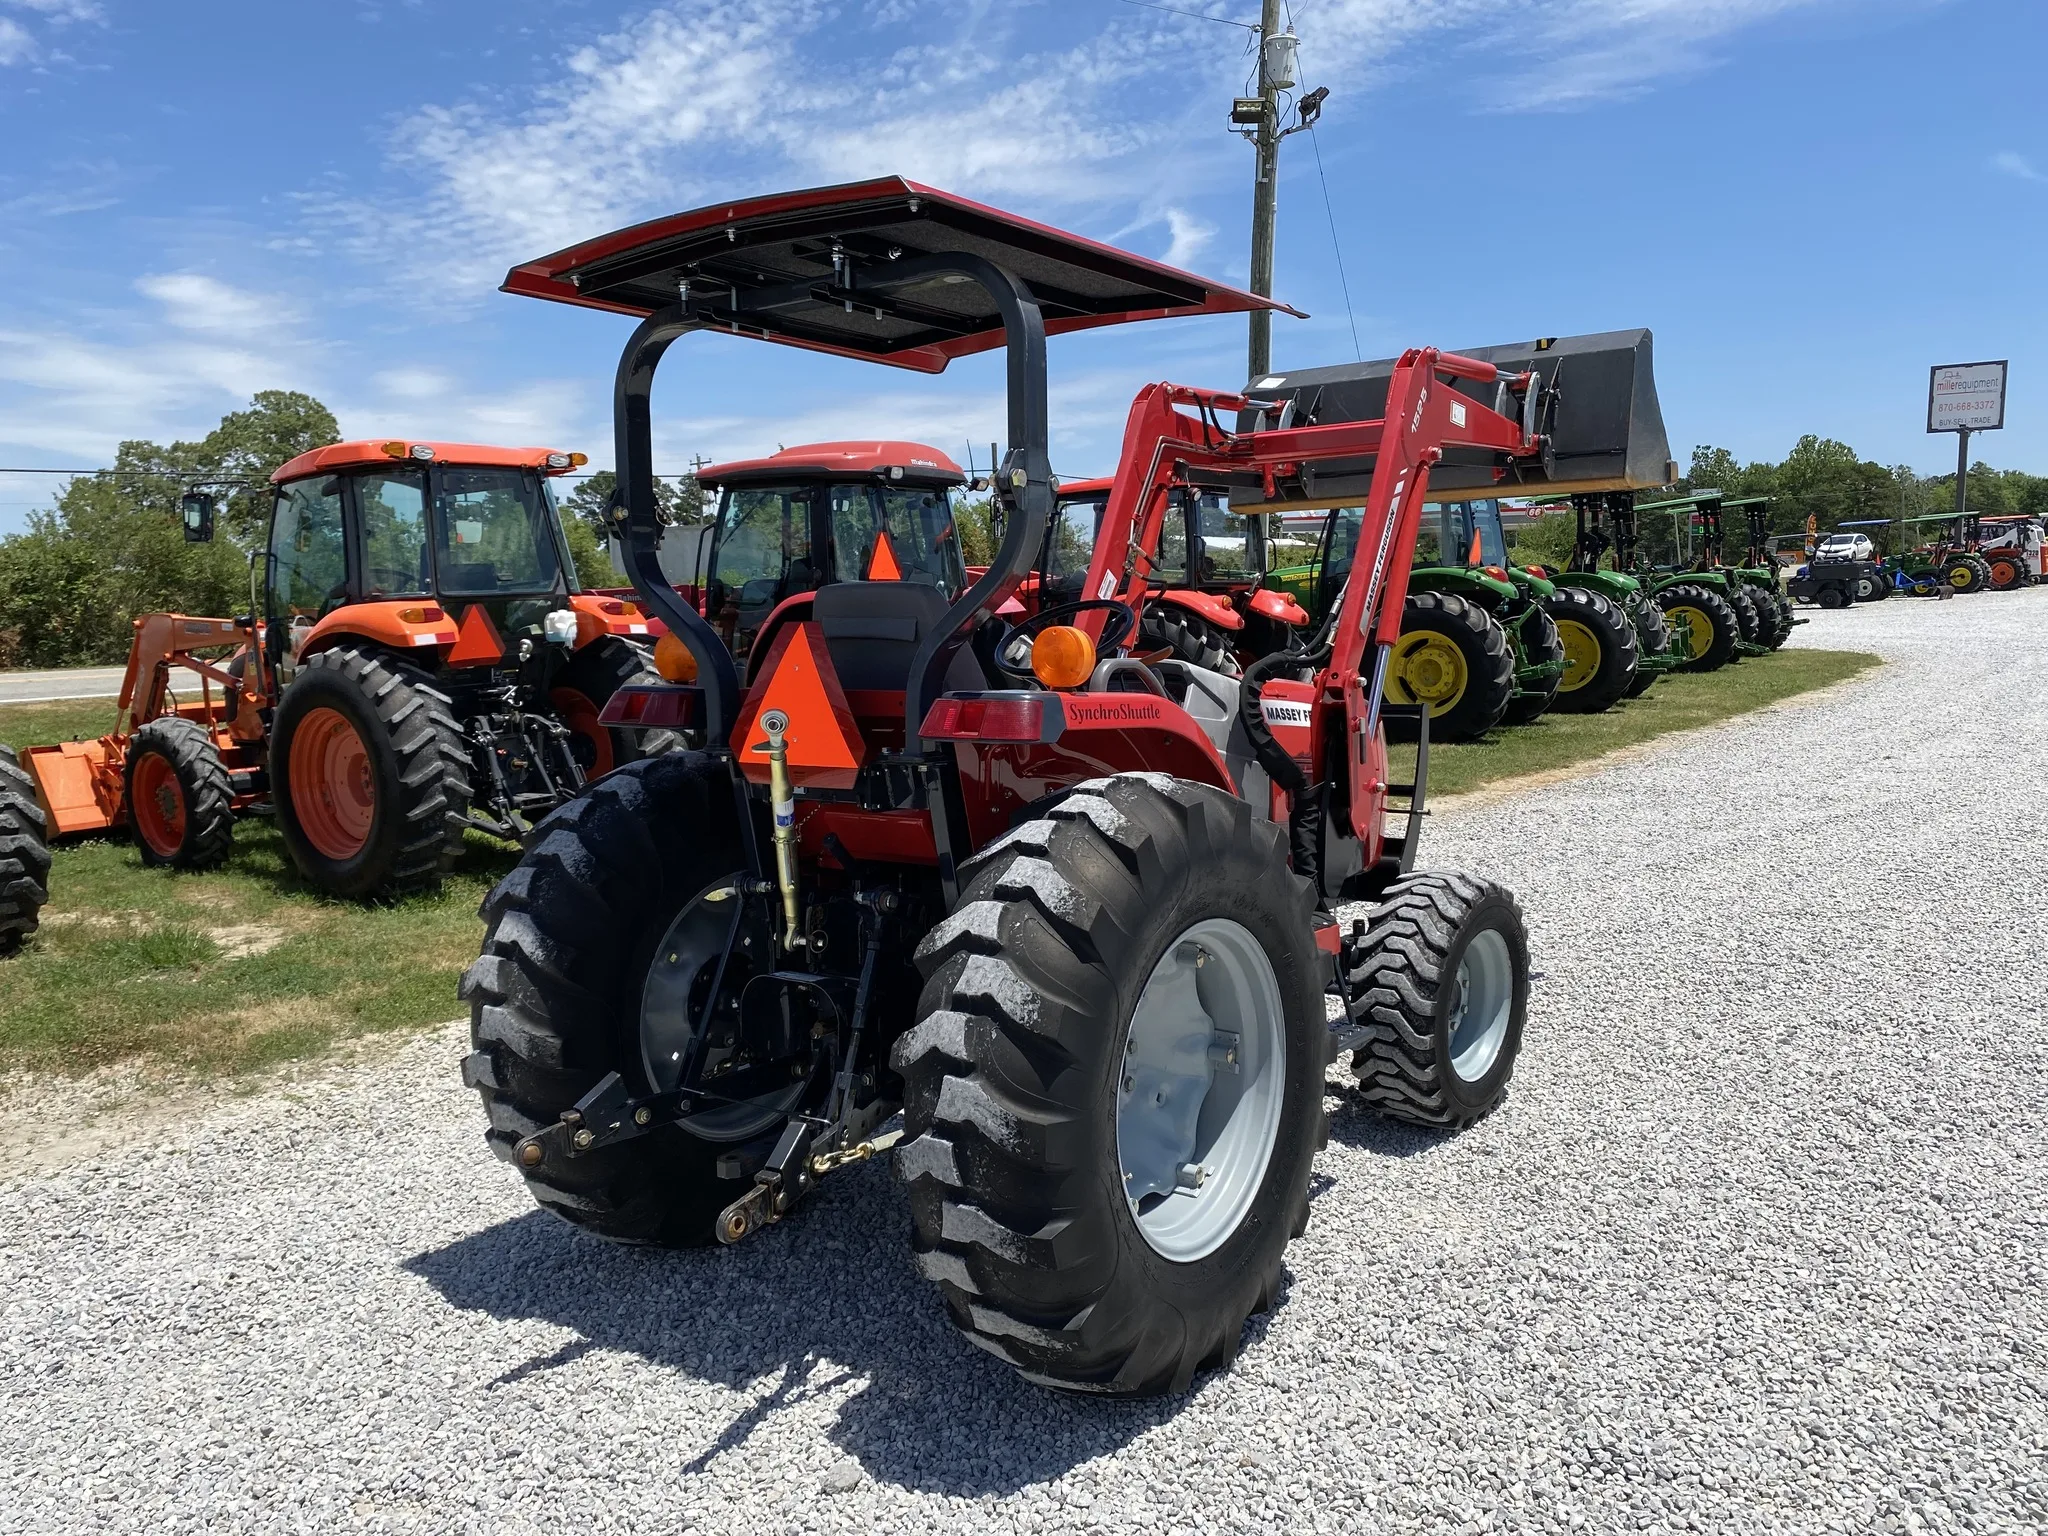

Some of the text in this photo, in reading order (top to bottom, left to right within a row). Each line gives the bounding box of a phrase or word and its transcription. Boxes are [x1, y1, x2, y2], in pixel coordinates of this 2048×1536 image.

[1411, 386, 1428, 433] 1525
[1938, 400, 1995, 412] 870-668-3372
[1529, 508, 1542, 516] 66
[1366, 508, 1395, 612] MASSEY FERGUSON
[613, 593, 643, 602] Mahin
[1069, 703, 1161, 724] SynchroShuttle
[1265, 706, 1302, 721] MASSEY
